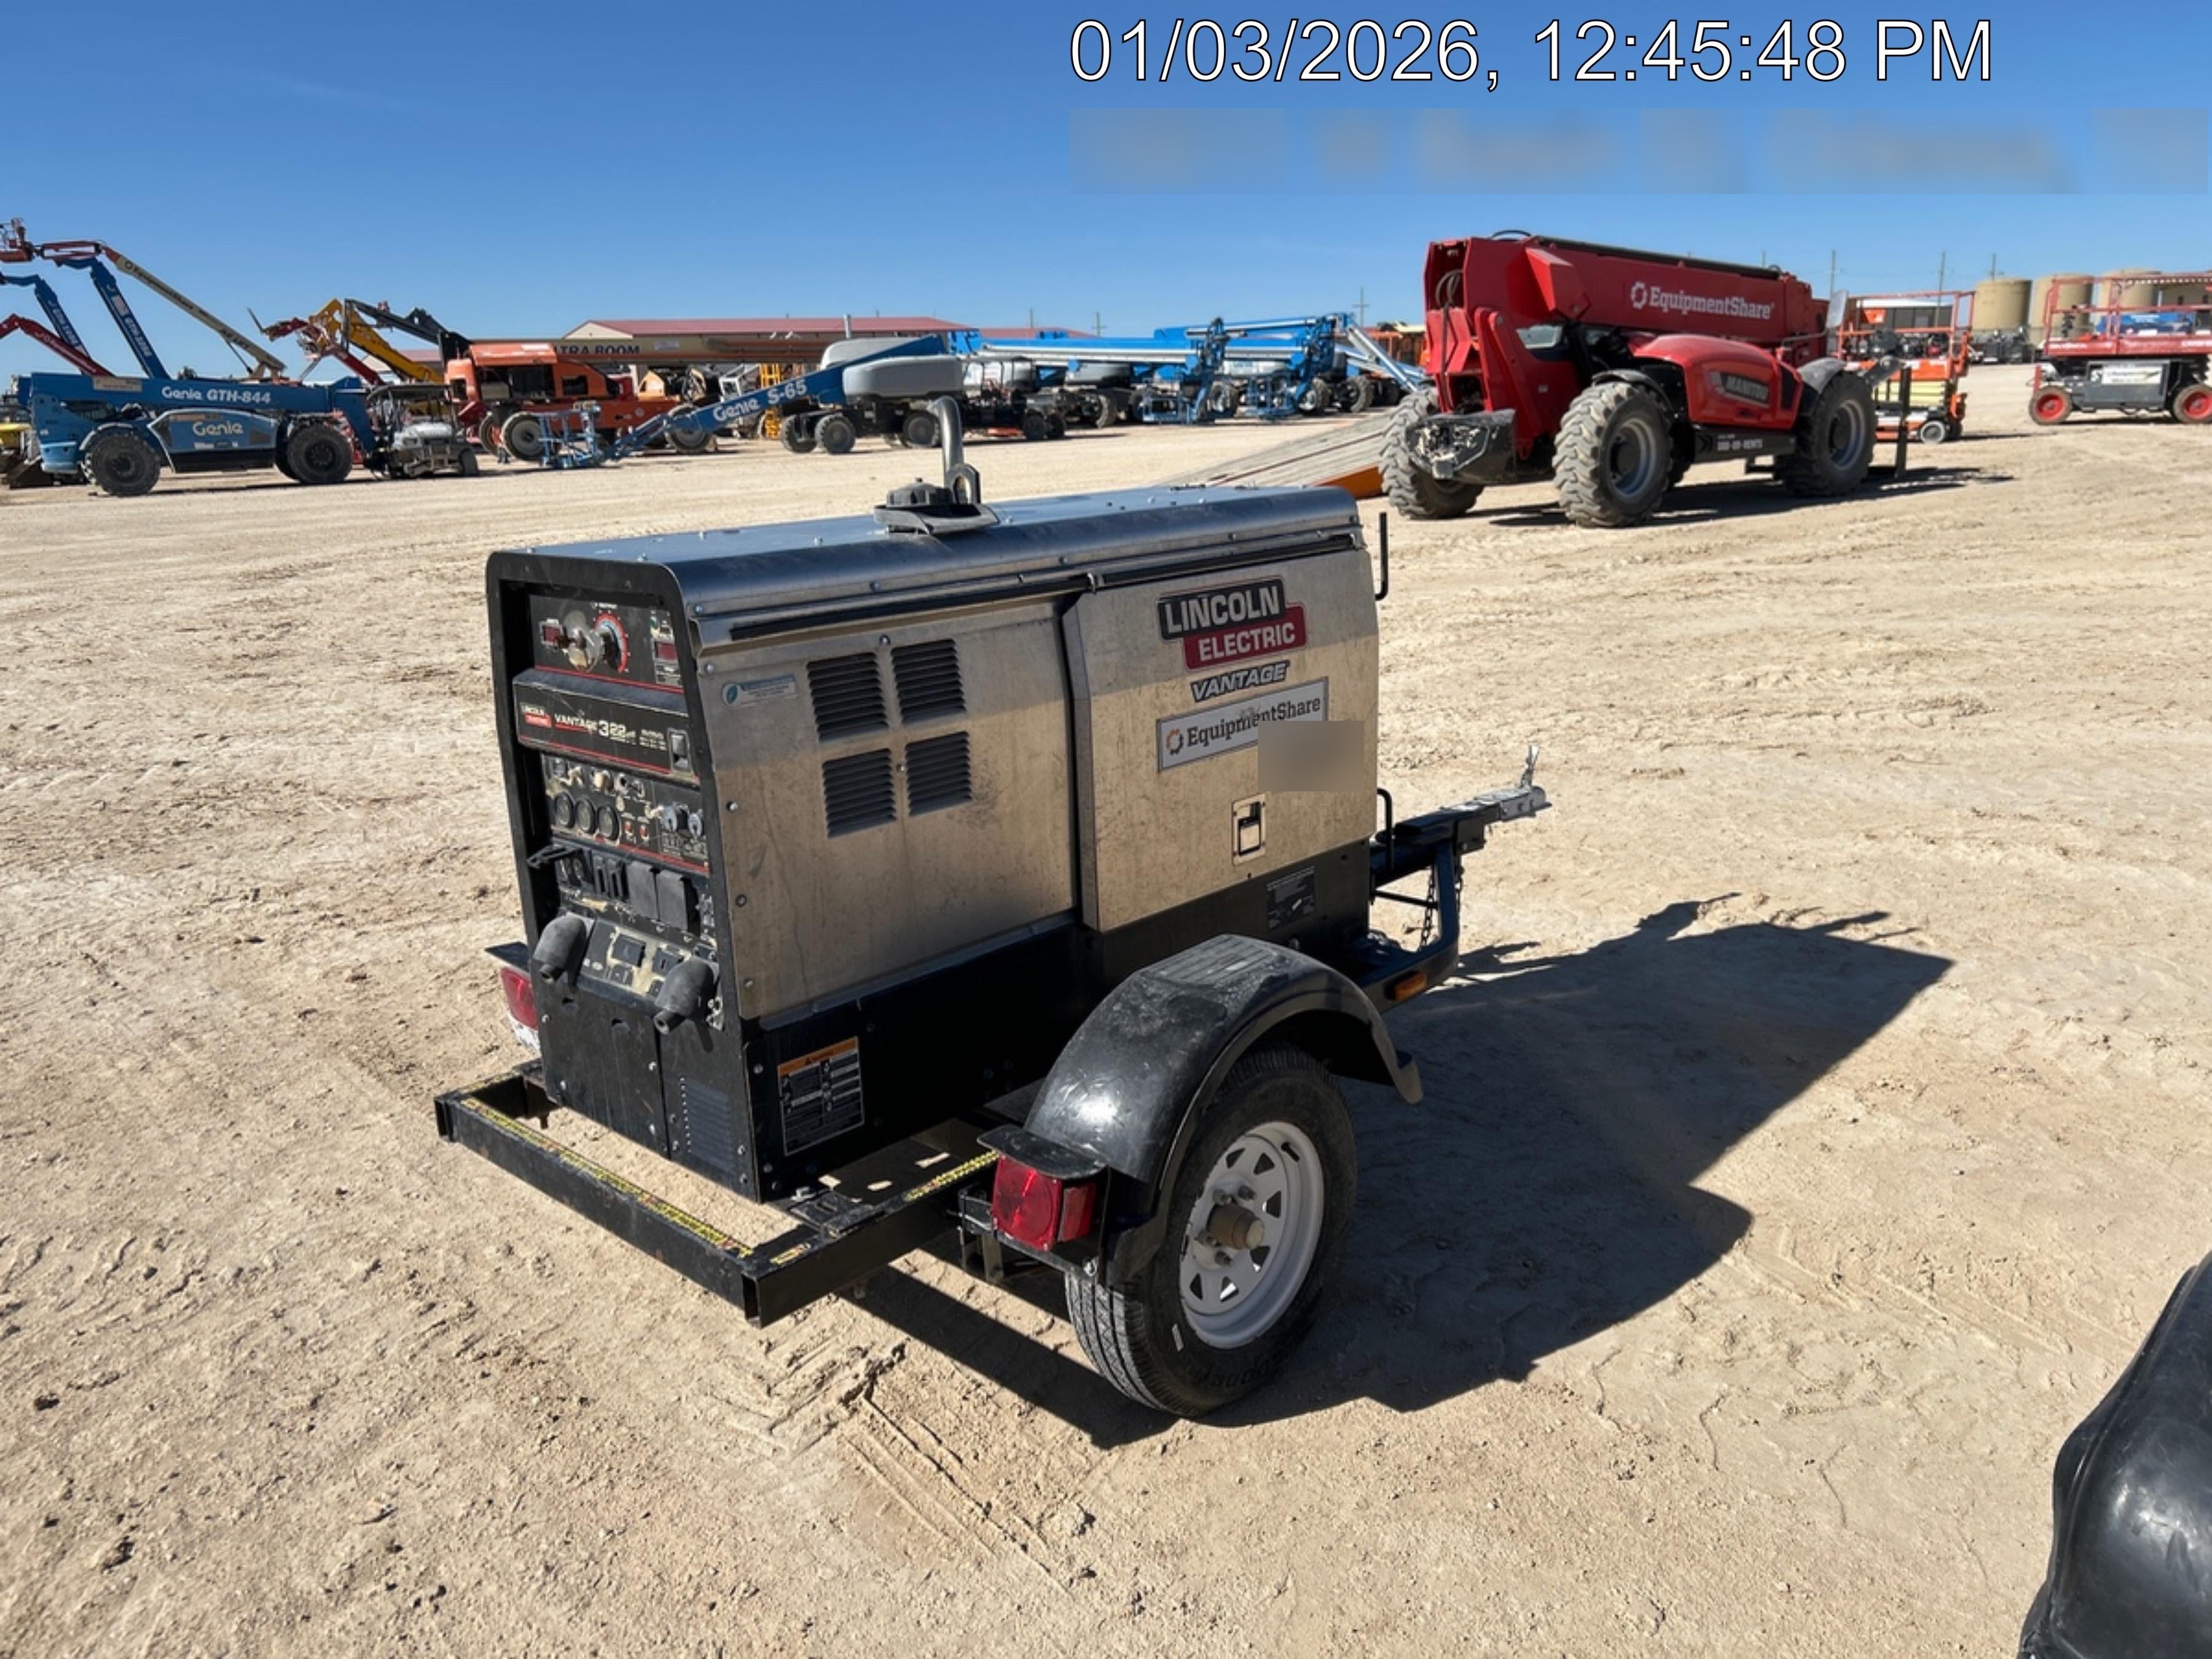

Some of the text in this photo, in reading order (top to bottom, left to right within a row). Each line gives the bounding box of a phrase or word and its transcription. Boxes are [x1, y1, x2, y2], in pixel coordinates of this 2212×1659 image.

[1649, 286, 1771, 320] EquipmentShare
[162, 386, 271, 404] Genie GTH-844
[713, 379, 807, 422] Genie S-65
[192, 420, 244, 436] Genie
[1165, 586, 1281, 633] LINCOLN
[1199, 622, 1295, 662] ELECTRIC
[1191, 661, 1288, 701] VANTAGE
[1186, 697, 1321, 747] EquipmentShare
